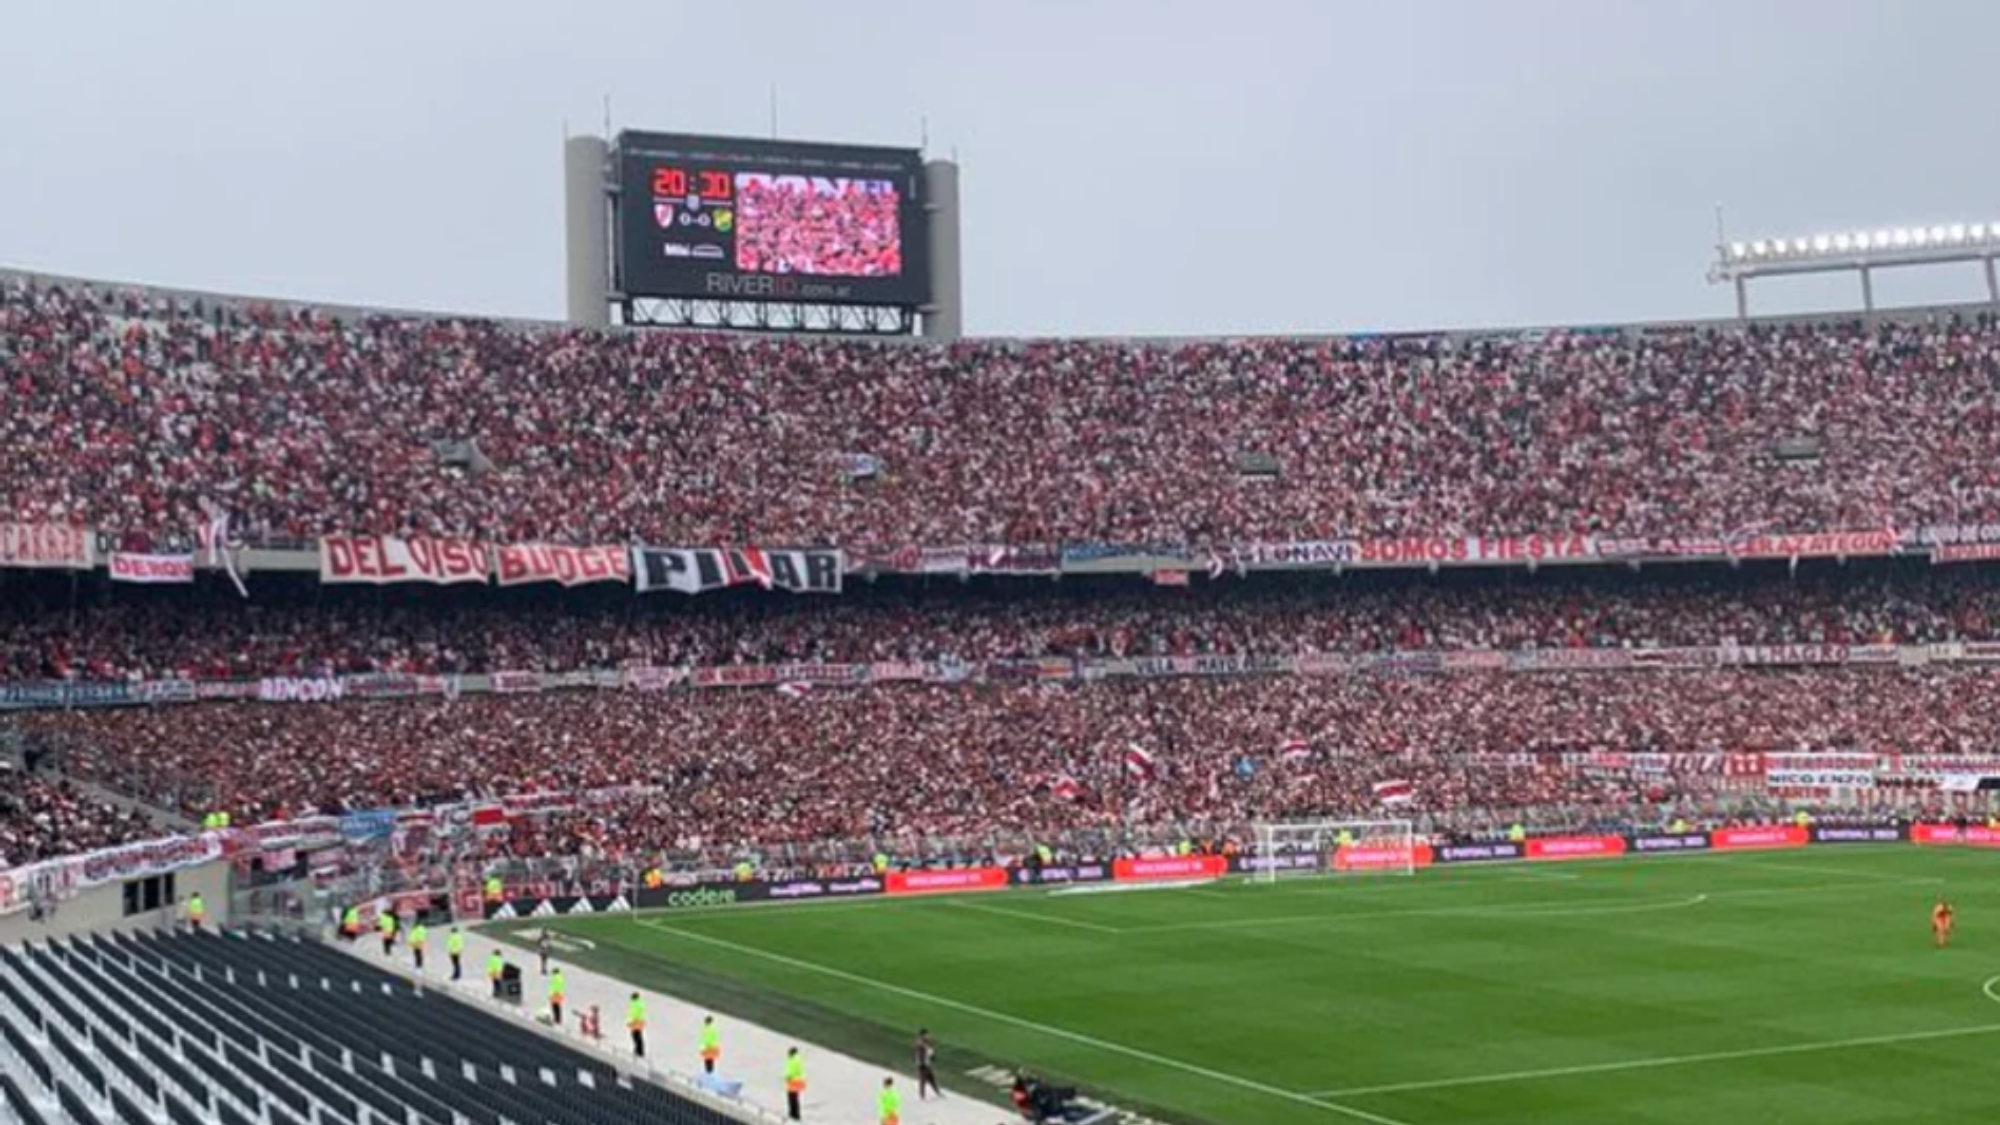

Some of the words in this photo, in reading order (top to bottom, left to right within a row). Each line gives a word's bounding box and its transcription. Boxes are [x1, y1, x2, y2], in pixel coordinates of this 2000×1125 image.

[326, 536, 405, 577] DEL
[405, 536, 488, 577] VISO
[1361, 538, 1467, 560] SOMOS
[1478, 533, 1589, 559] FIESTA
[500, 546, 629, 579] BUDGE
[643, 549, 838, 589] PILAR
[1768, 773, 1814, 784] NICO
[1819, 773, 1870, 785] ENZO
[668, 886, 737, 907] codere
